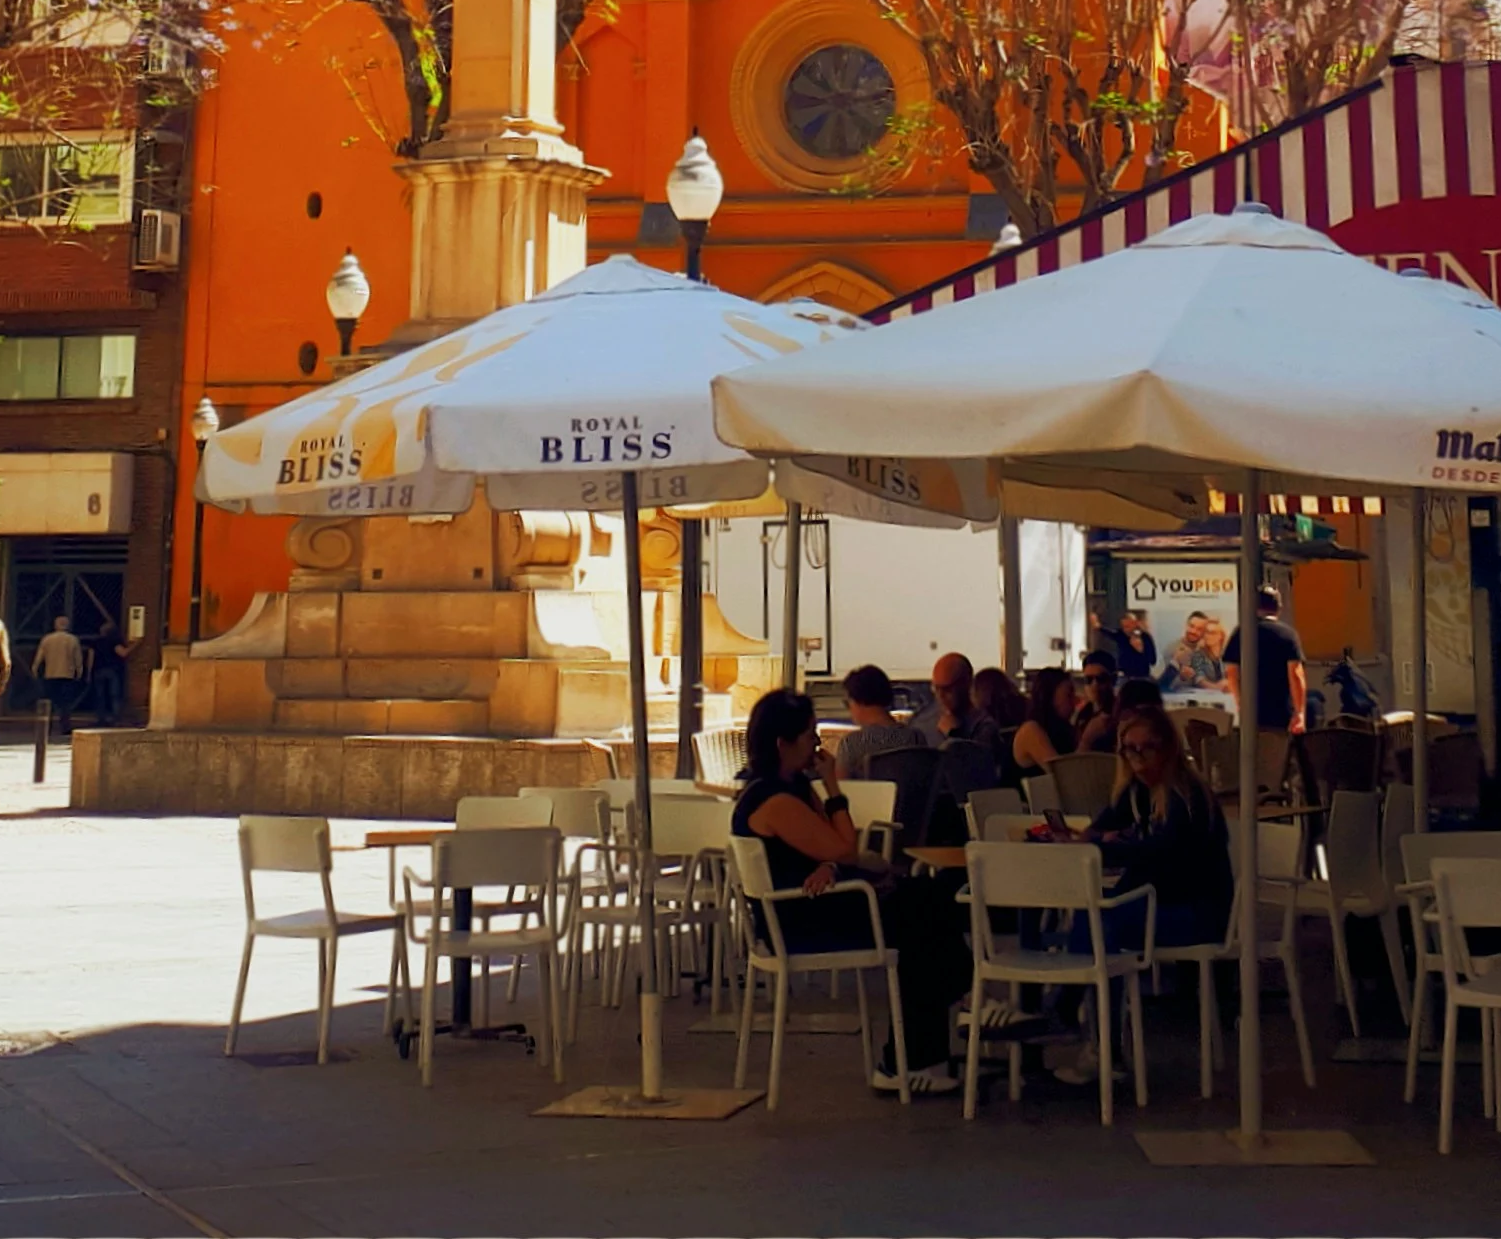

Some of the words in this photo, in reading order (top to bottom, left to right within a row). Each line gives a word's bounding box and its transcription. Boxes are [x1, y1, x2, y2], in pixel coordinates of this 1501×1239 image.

[570, 415, 643, 433] ROYAL
[300, 434, 346, 453] ROYAL
[540, 431, 673, 464] BLISS
[276, 449, 363, 485] BLISS
[1431, 466, 1501, 484] DESDE
[87, 492, 102, 517] 6
[1158, 578, 1235, 593] YOUPISO
